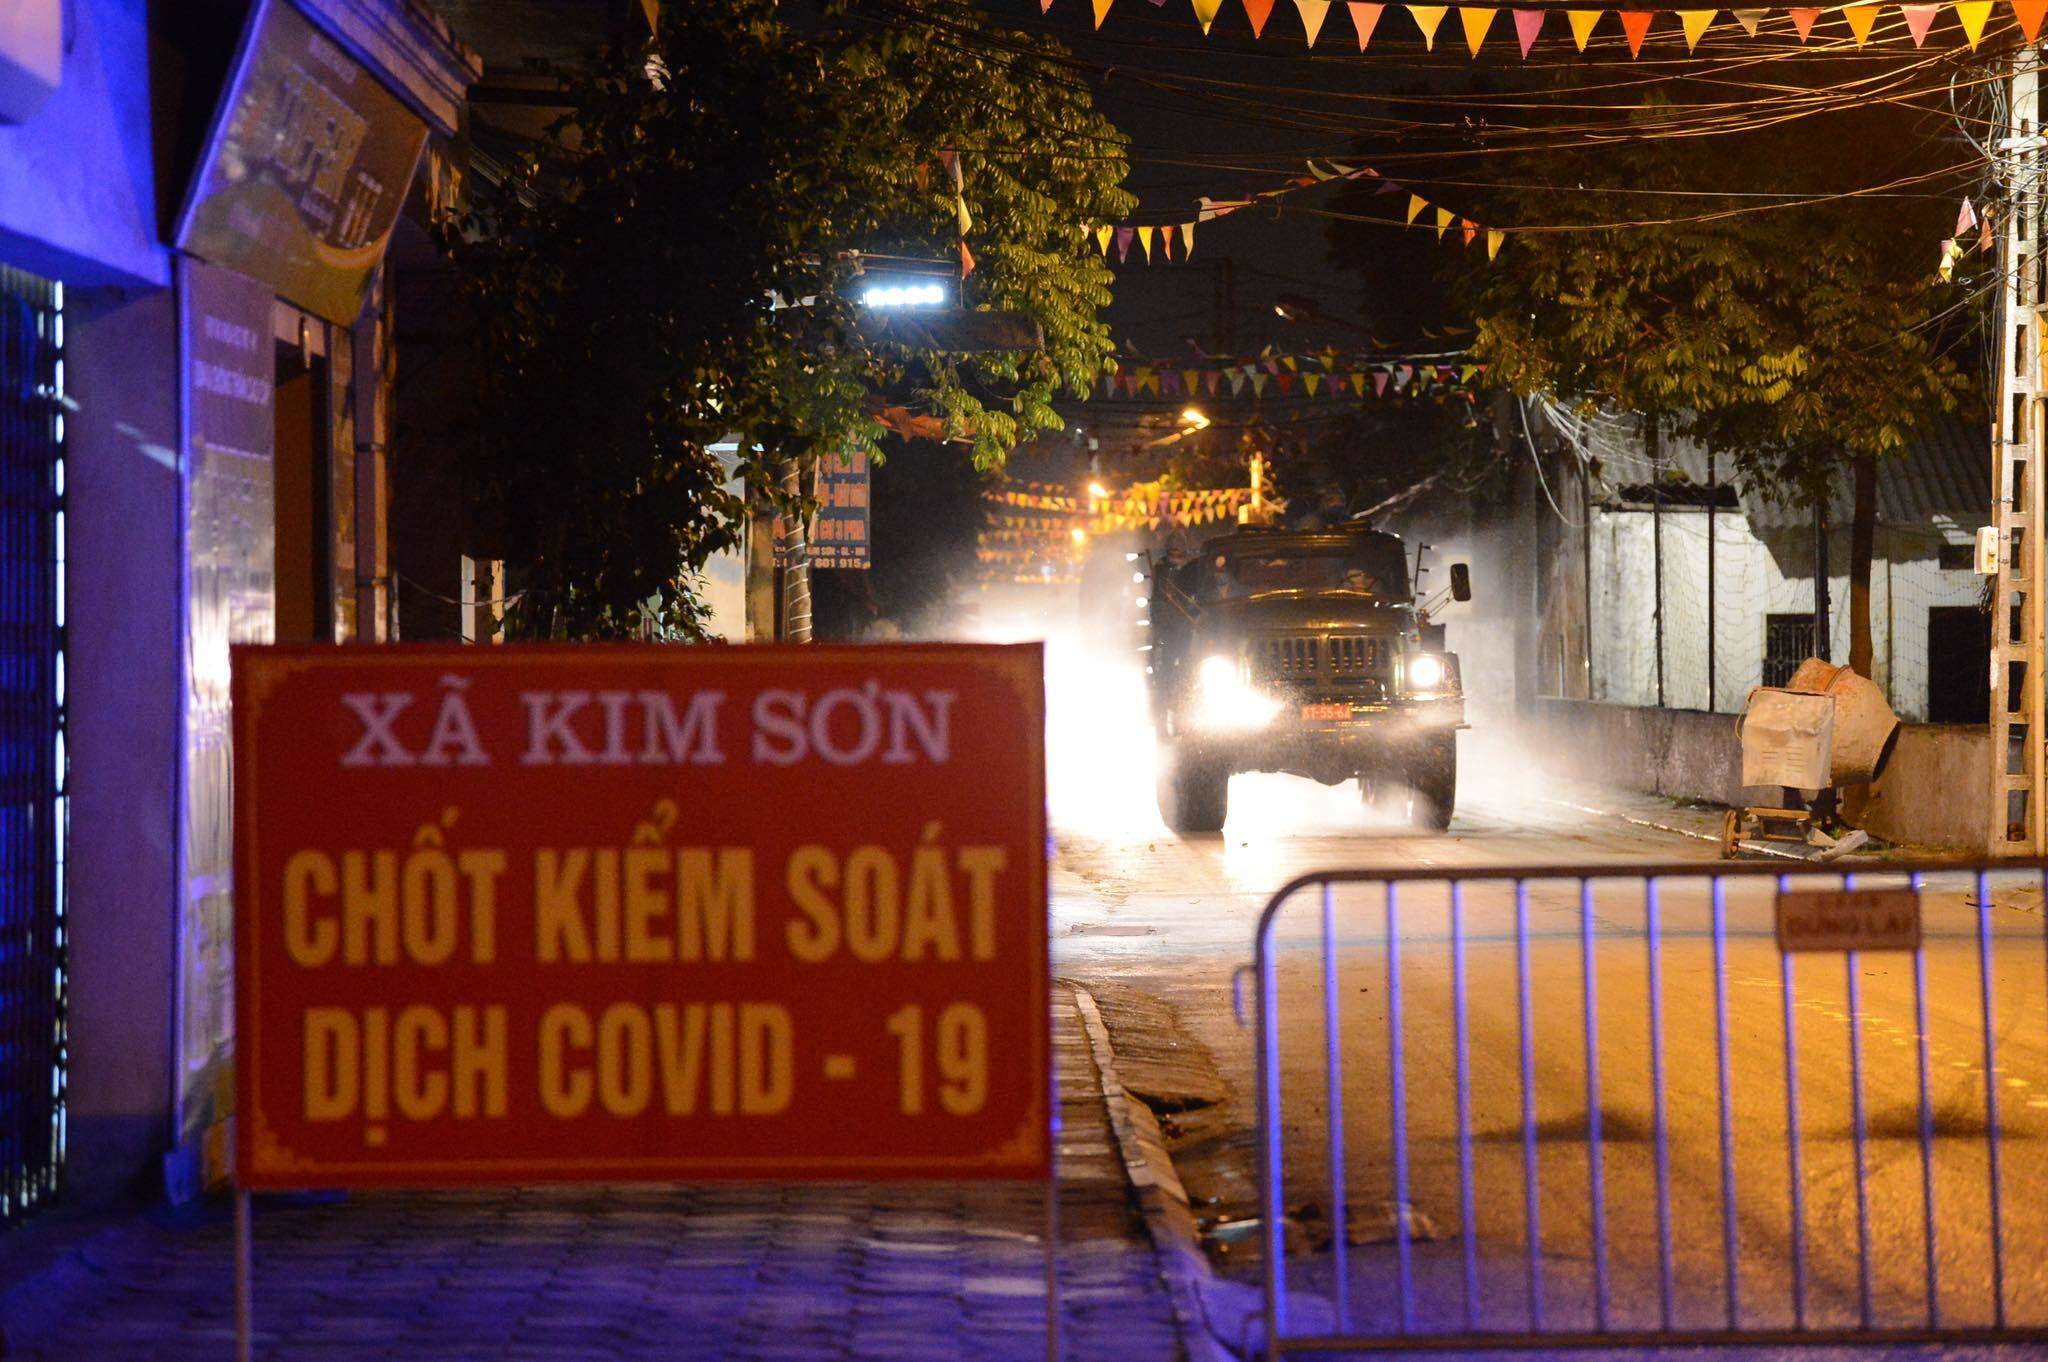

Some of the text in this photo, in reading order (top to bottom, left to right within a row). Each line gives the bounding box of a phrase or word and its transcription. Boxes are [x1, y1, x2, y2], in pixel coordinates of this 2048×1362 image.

[342, 674, 955, 766] XÃ KIM SƠN
[283, 799, 1007, 965] CHỐT KIỂM SOÁT
[303, 1006, 508, 1146] DỊCH
[538, 1003, 794, 1117] COVID
[887, 1003, 988, 1115] 19
